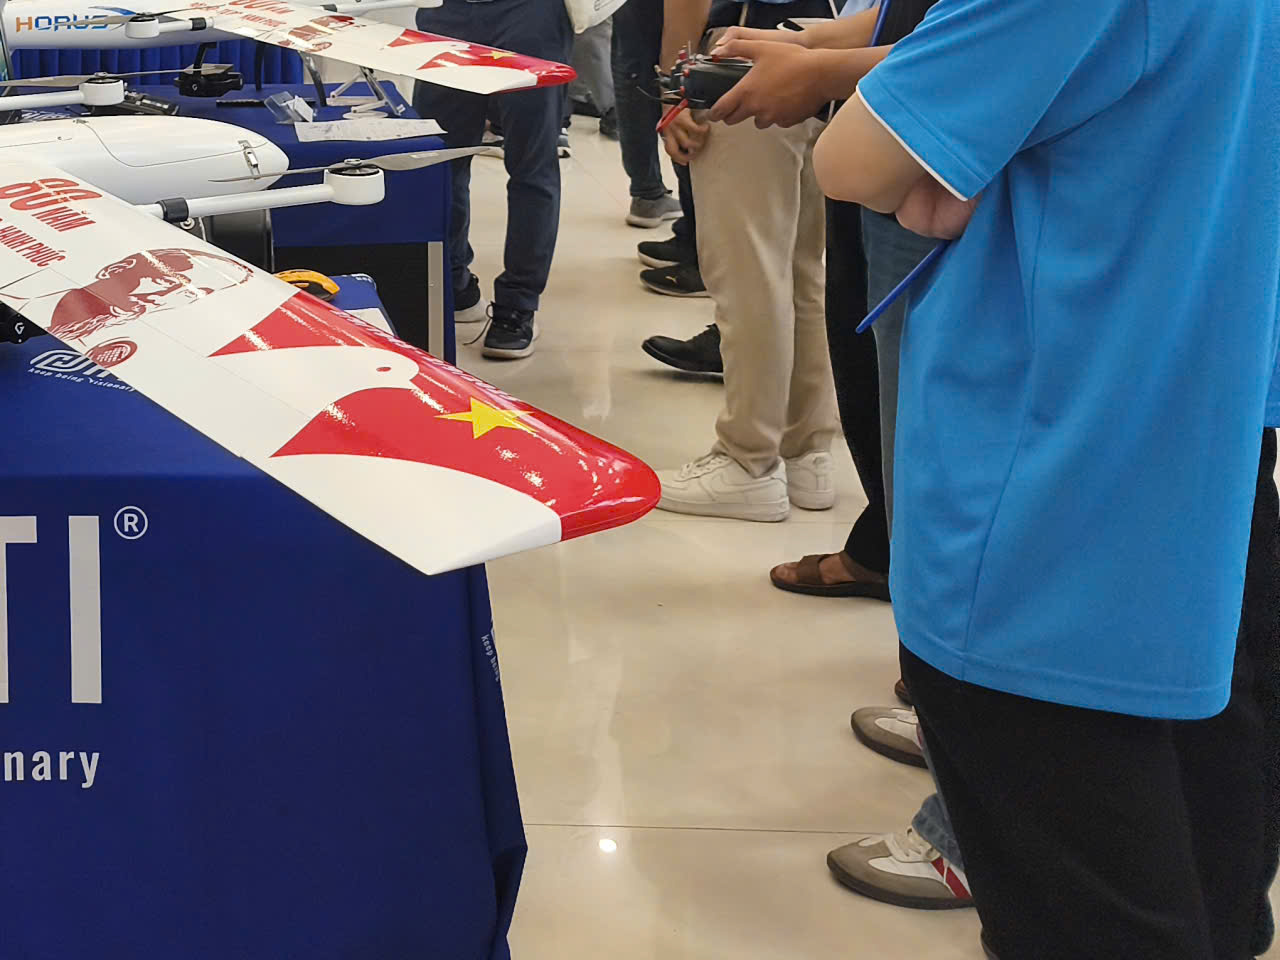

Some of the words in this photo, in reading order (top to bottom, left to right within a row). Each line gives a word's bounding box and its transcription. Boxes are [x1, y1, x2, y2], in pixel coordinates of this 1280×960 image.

[16, 14, 109, 33] HORUS
[31, 205, 96, 232] NĂM
[21, 240, 67, 267] PHÚC
